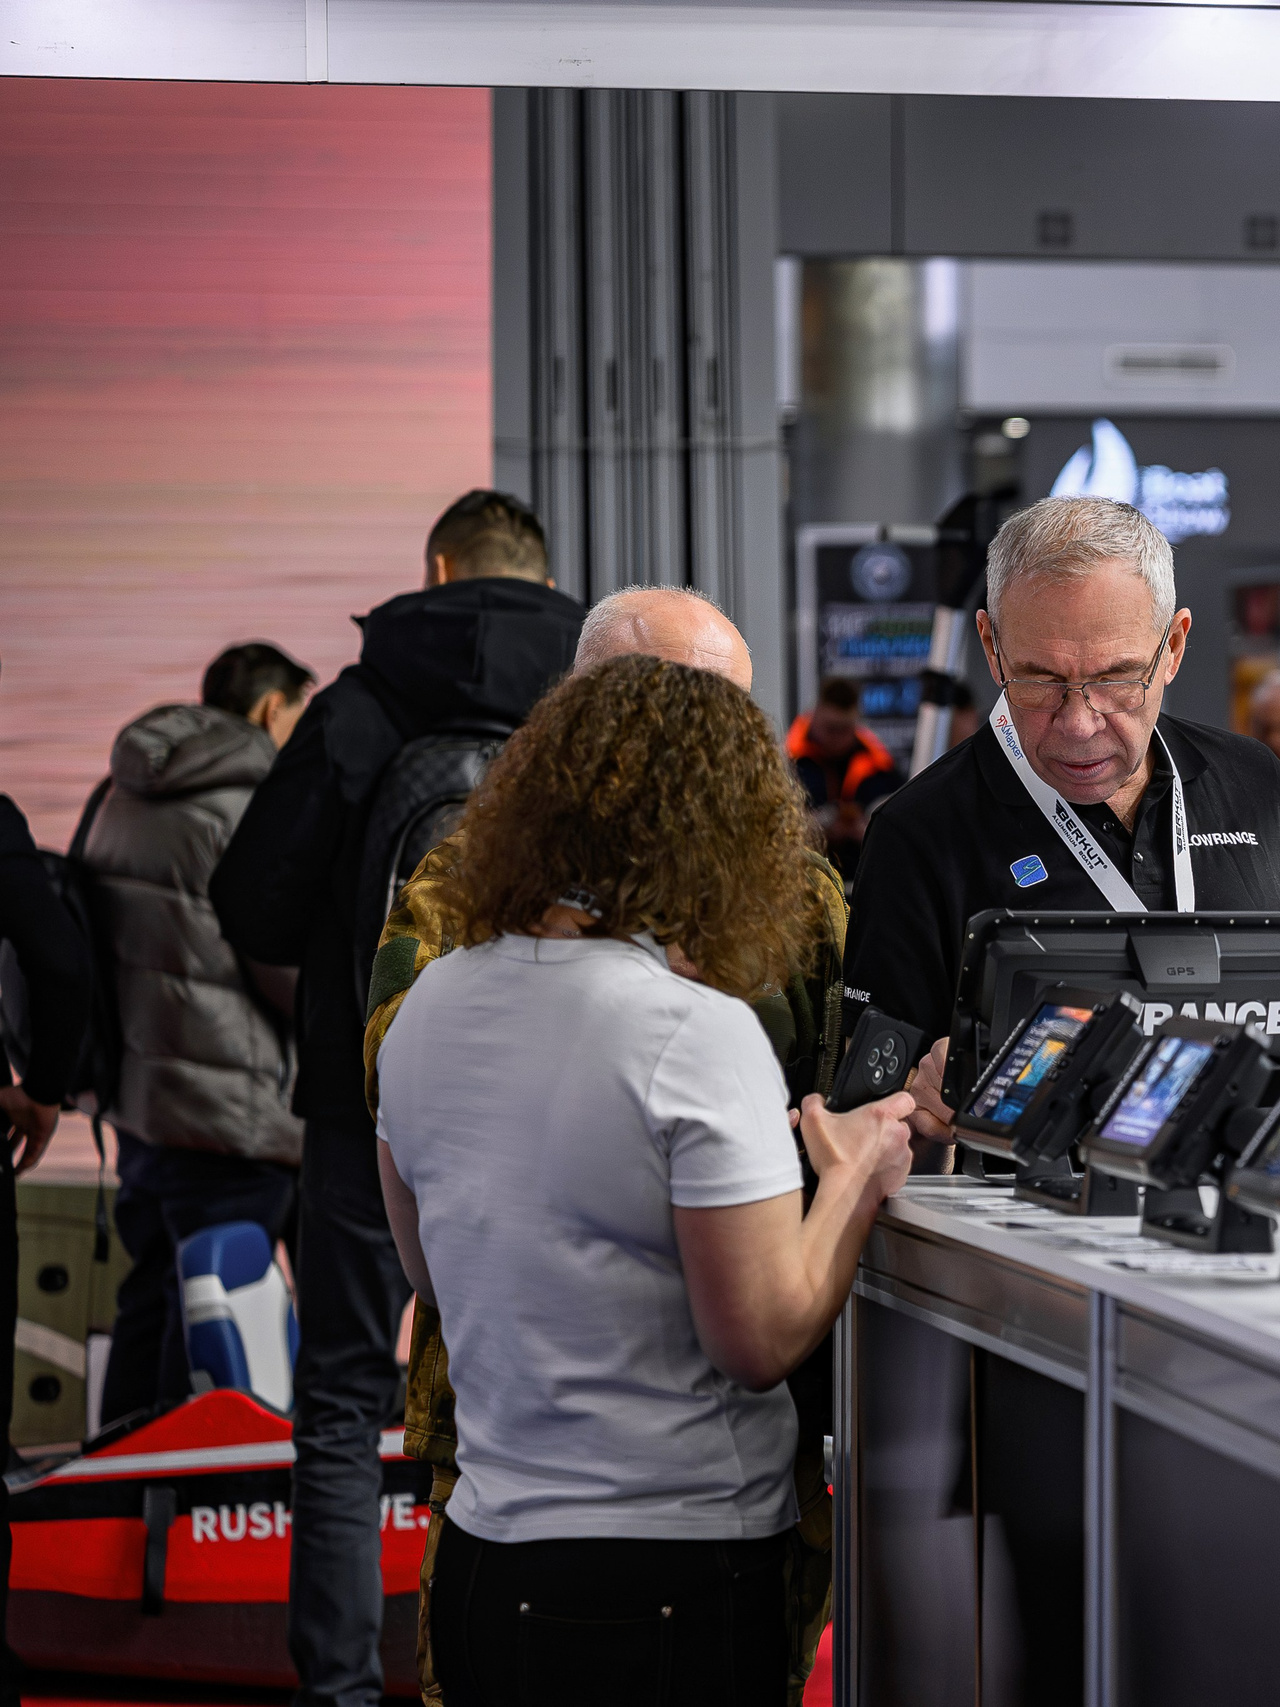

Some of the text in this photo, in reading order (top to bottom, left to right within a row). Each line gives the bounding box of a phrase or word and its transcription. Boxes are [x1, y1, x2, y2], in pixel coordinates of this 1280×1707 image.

[1052, 815, 1094, 870] ALUMINIUM BOATS
[1167, 967, 1195, 976] GPS
